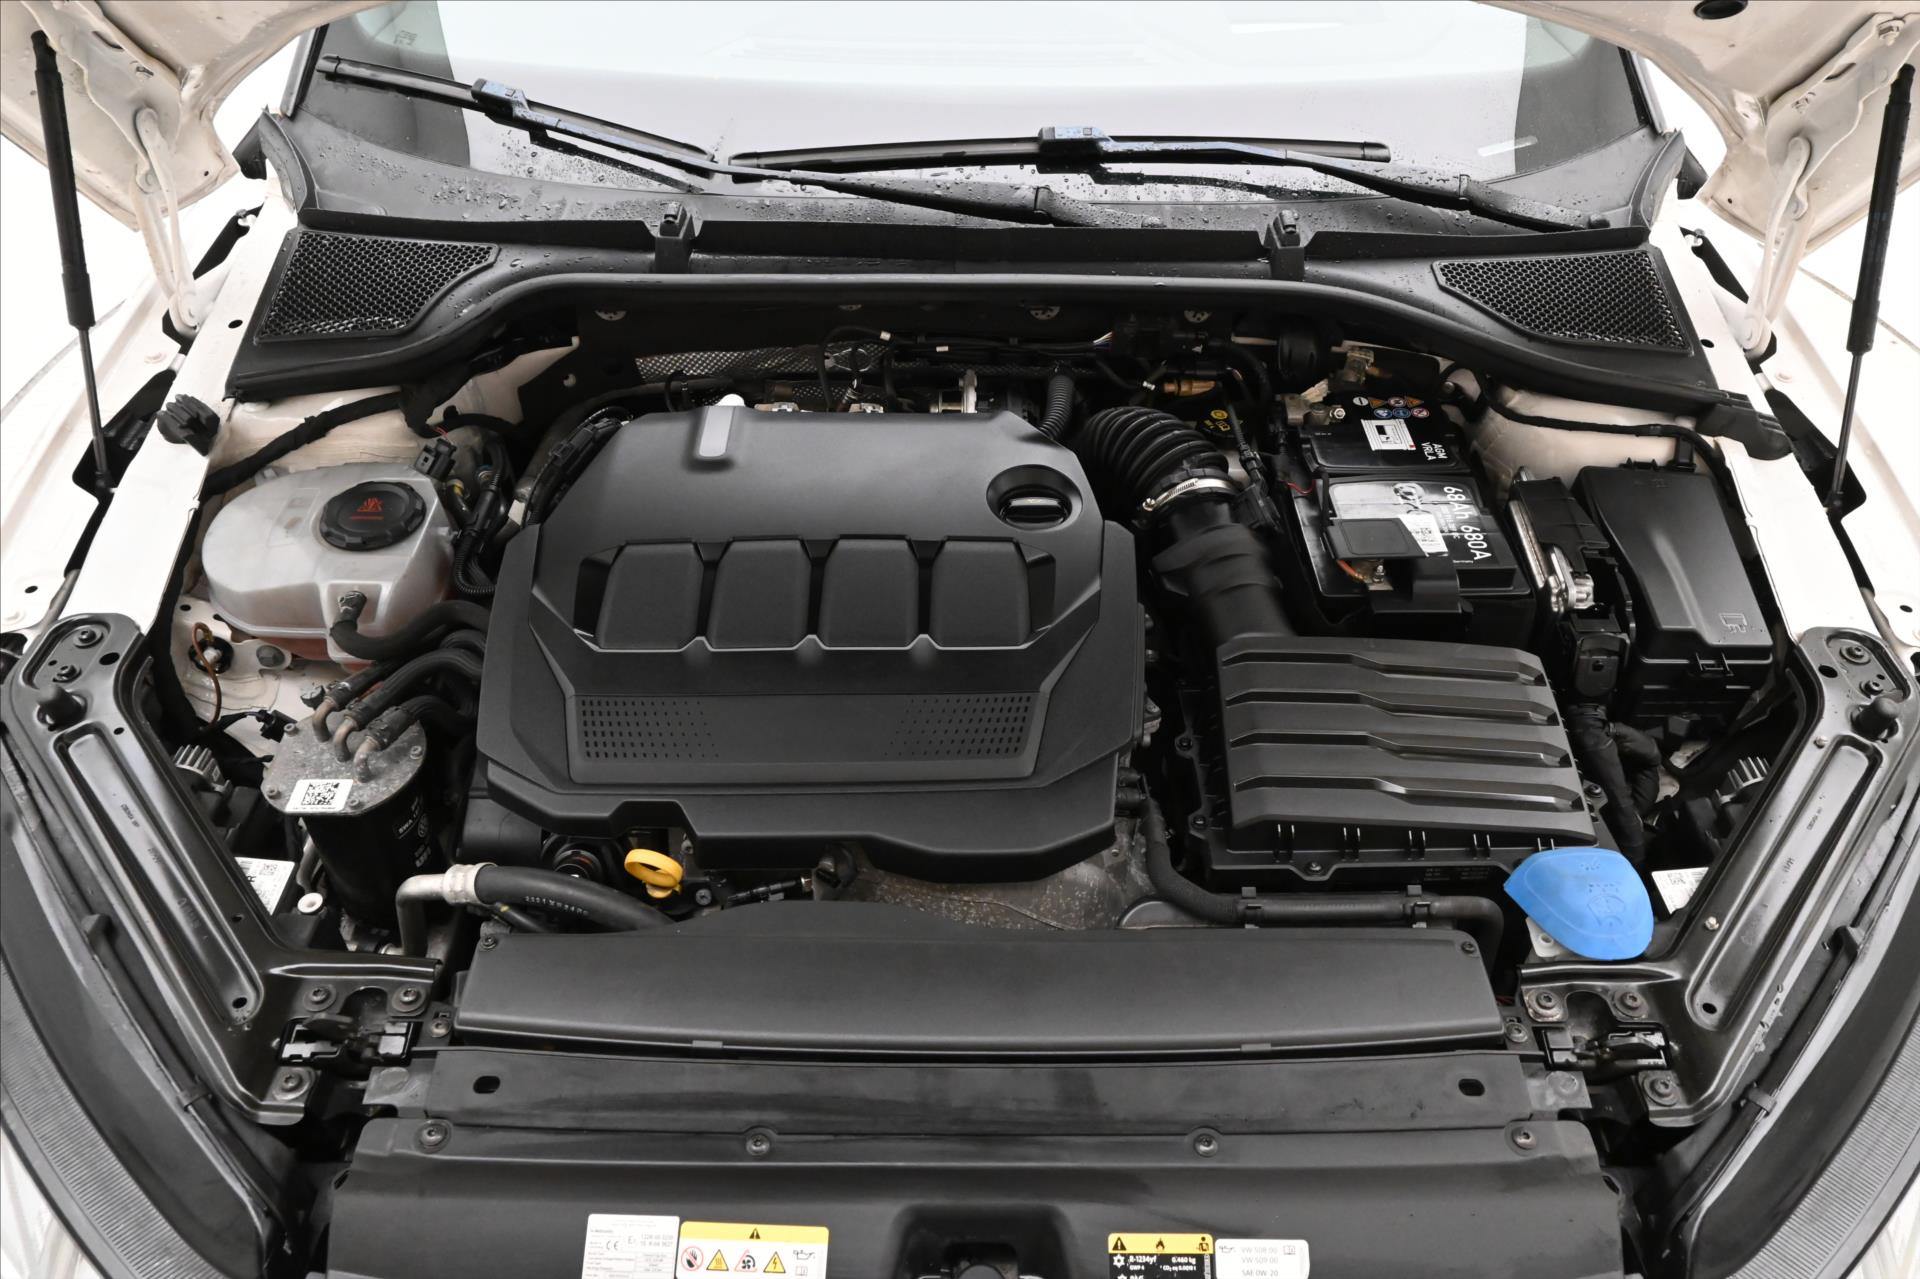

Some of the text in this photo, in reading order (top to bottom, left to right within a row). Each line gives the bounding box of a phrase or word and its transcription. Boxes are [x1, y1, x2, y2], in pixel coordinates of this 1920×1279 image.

[1421, 441, 1437, 461] VRLA
[1432, 443, 1448, 460] AGM
[1443, 486, 1473, 520] 68Ah
[1460, 525, 1492, 560] 680A
[1188, 1256, 1196, 1265] kg
